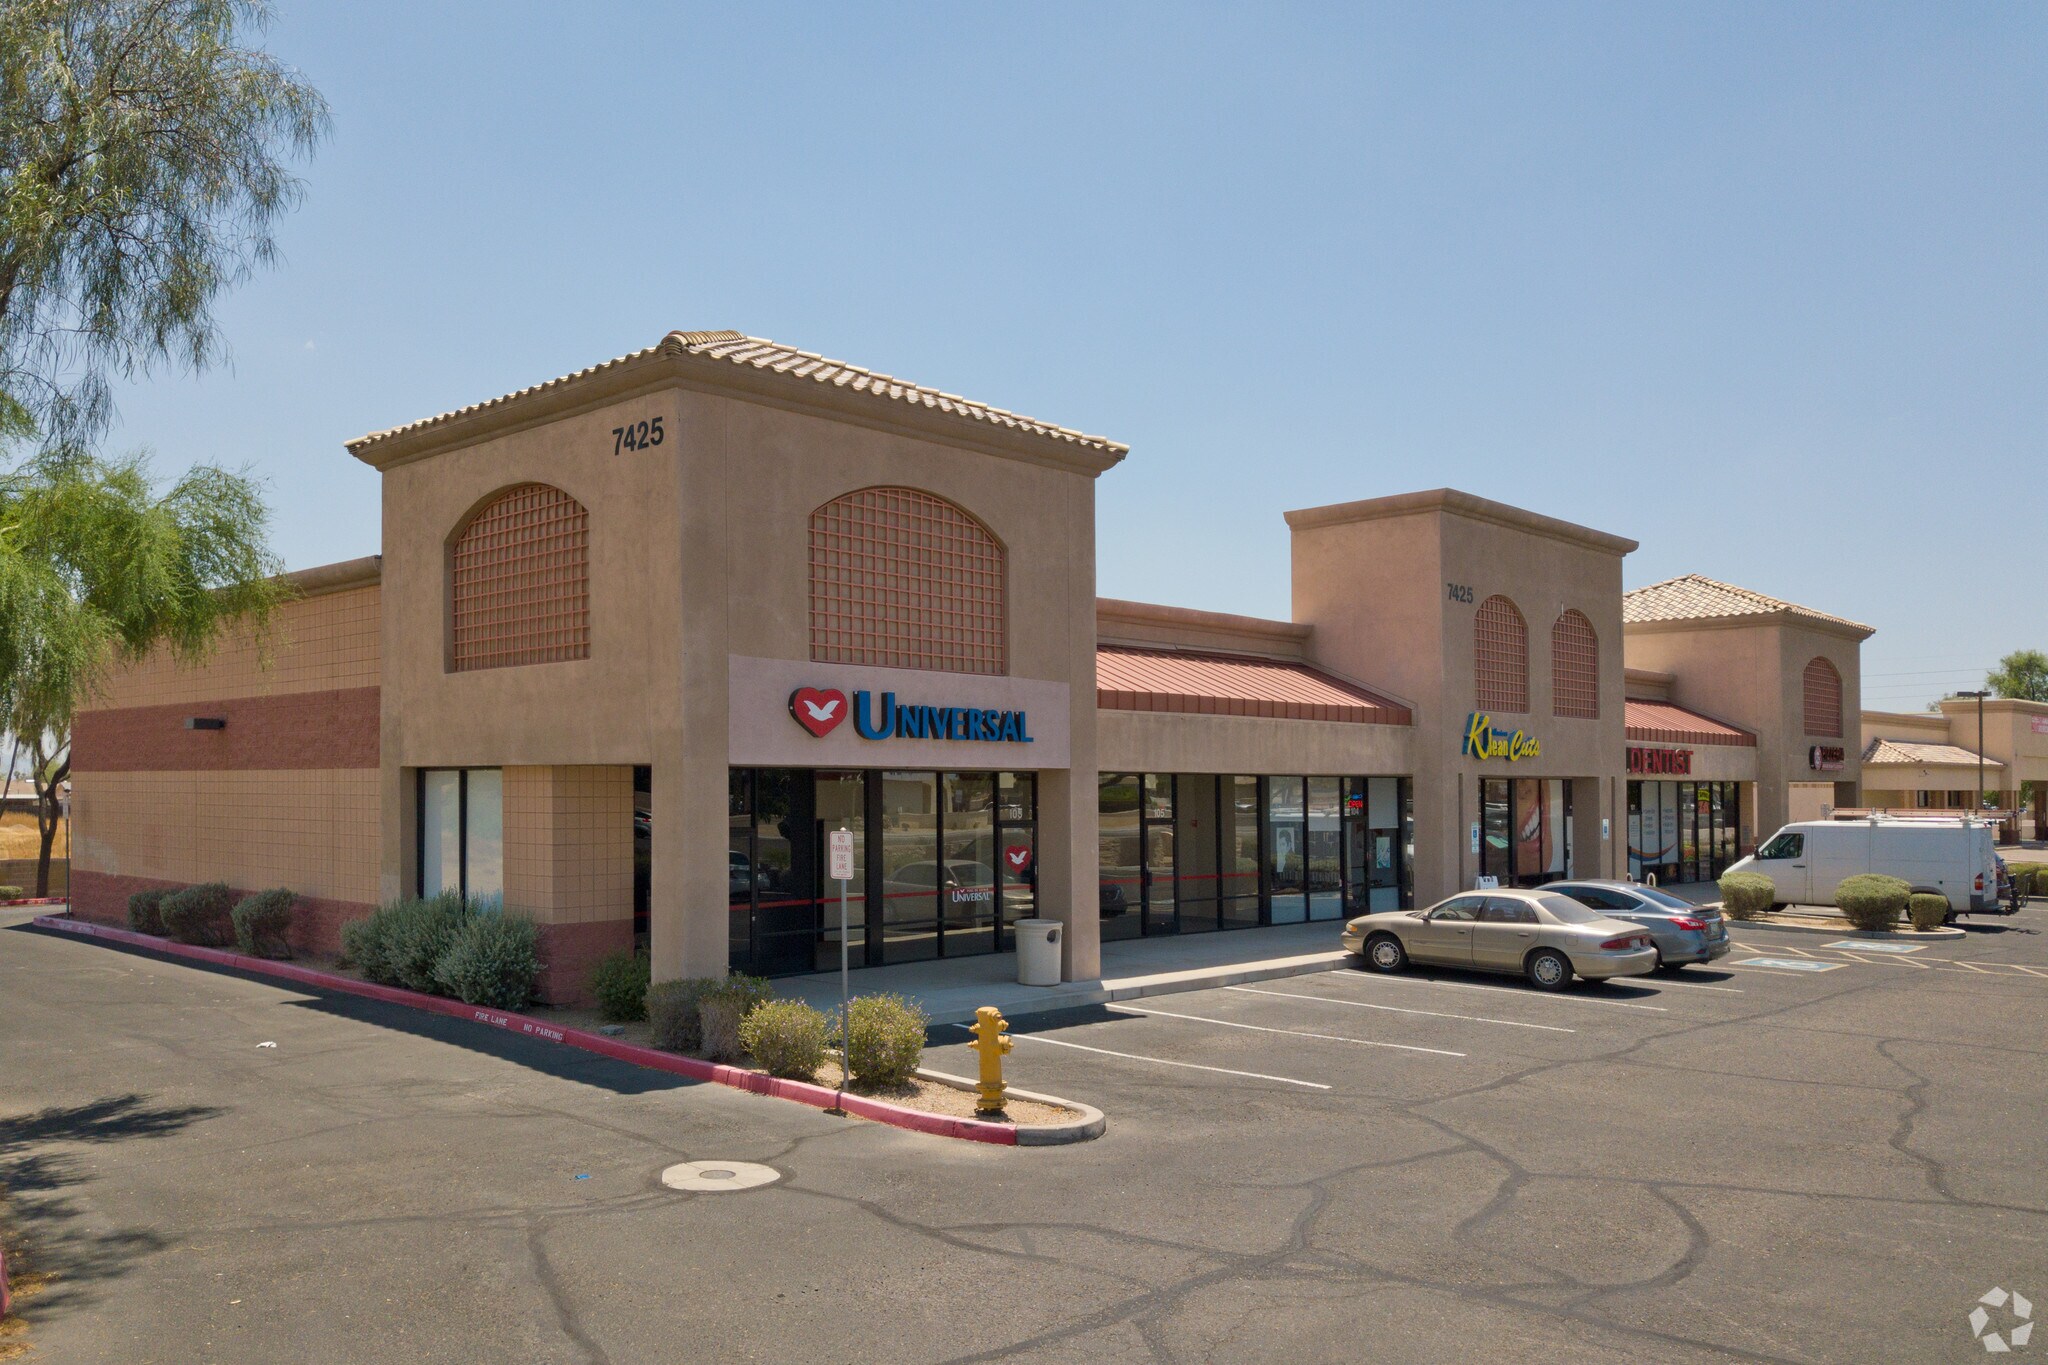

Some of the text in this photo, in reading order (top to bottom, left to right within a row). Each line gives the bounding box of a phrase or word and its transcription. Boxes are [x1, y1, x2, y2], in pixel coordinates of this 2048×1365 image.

[612, 416, 664, 456] 7425
[1447, 583, 1474, 604] 7425
[853, 690, 1034, 743] UNIVERSAL
[1462, 712, 1540, 762] Klean Cuts
[1628, 747, 1694, 775] DENTIST
[1154, 808, 1165, 818] 105
[837, 835, 846, 843] NO
[832, 844, 851, 853] PARKING
[836, 854, 847, 862] FIRE
[836, 863, 848, 871] LANE
[952, 890, 990, 903] UNIVERSAL
[474, 1011, 508, 1027] FIRE LANE
[523, 1023, 563, 1041] NO PARKING
